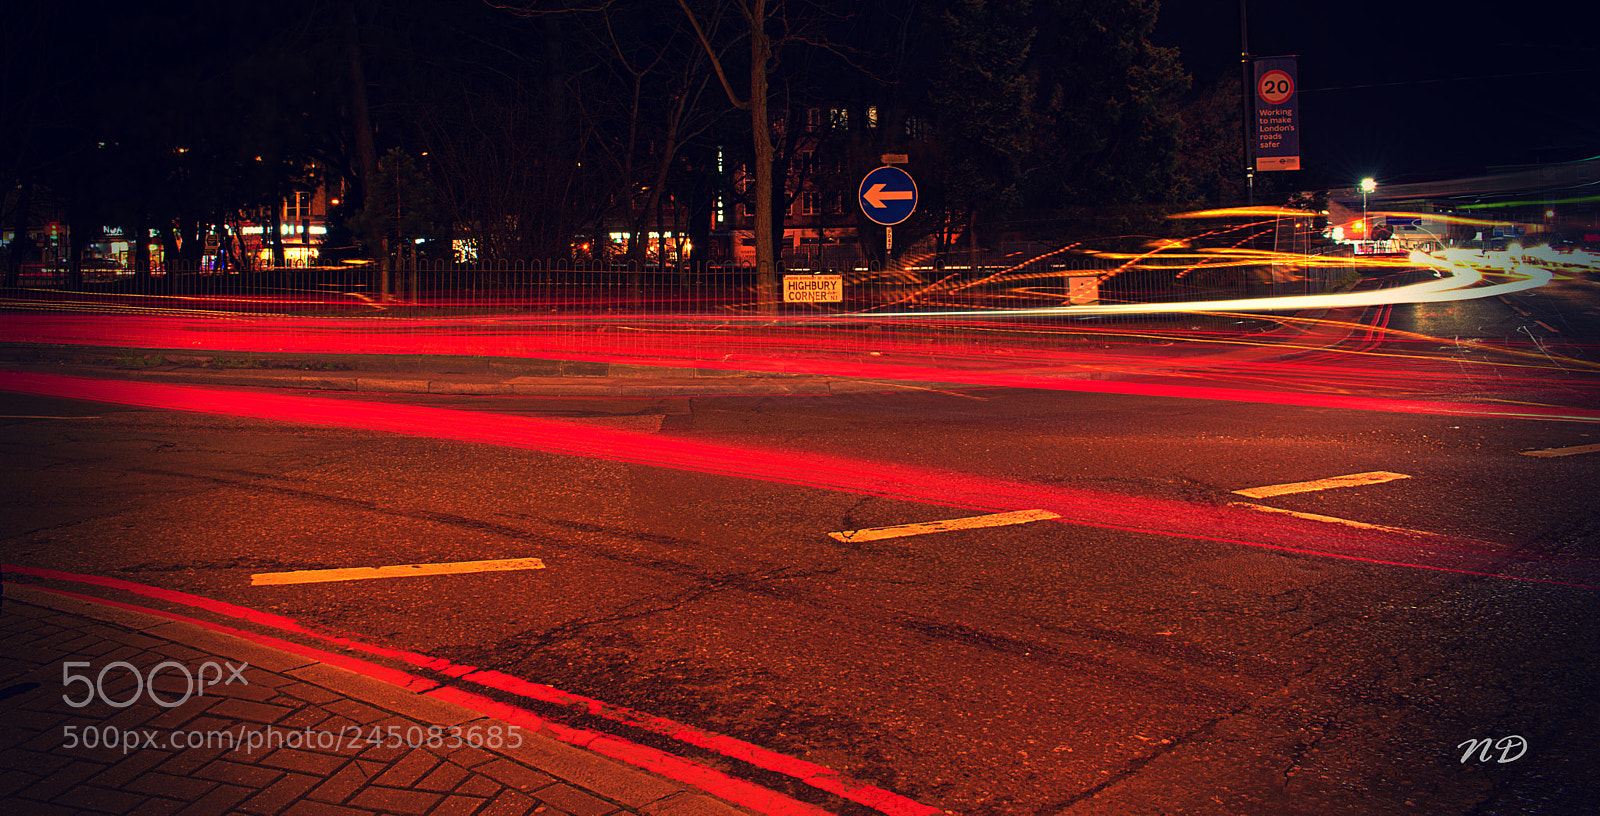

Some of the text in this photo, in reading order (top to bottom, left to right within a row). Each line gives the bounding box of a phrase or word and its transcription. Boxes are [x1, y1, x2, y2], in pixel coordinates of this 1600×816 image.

[1264, 80, 1289, 94] 20
[1259, 109, 1292, 117] Working
[1270, 116, 1292, 124] make
[788, 281, 837, 290] HIGHBURY
[788, 291, 827, 300] CORNER
